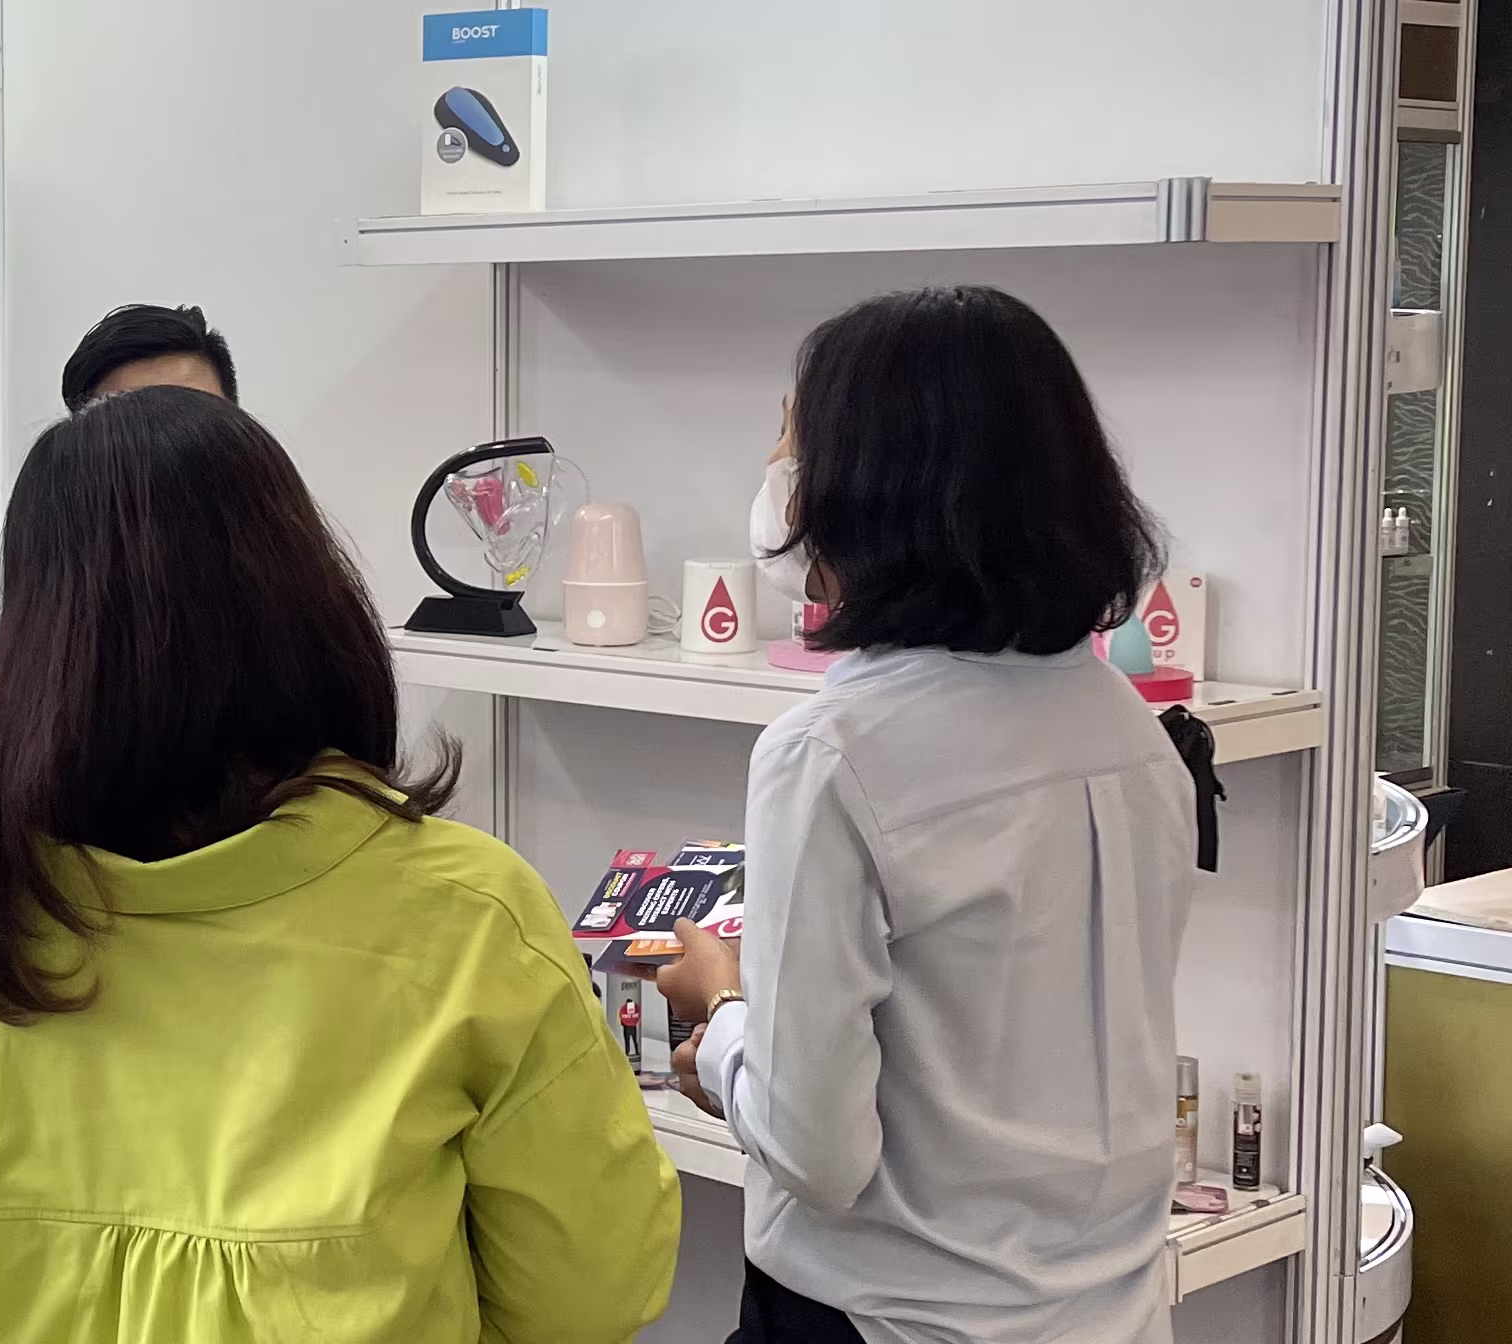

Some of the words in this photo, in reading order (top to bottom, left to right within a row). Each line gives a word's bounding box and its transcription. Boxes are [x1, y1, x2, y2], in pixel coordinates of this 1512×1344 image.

[451, 24, 501, 40] BOOST
[703, 606, 735, 640] G
[1144, 609, 1176, 643] G
